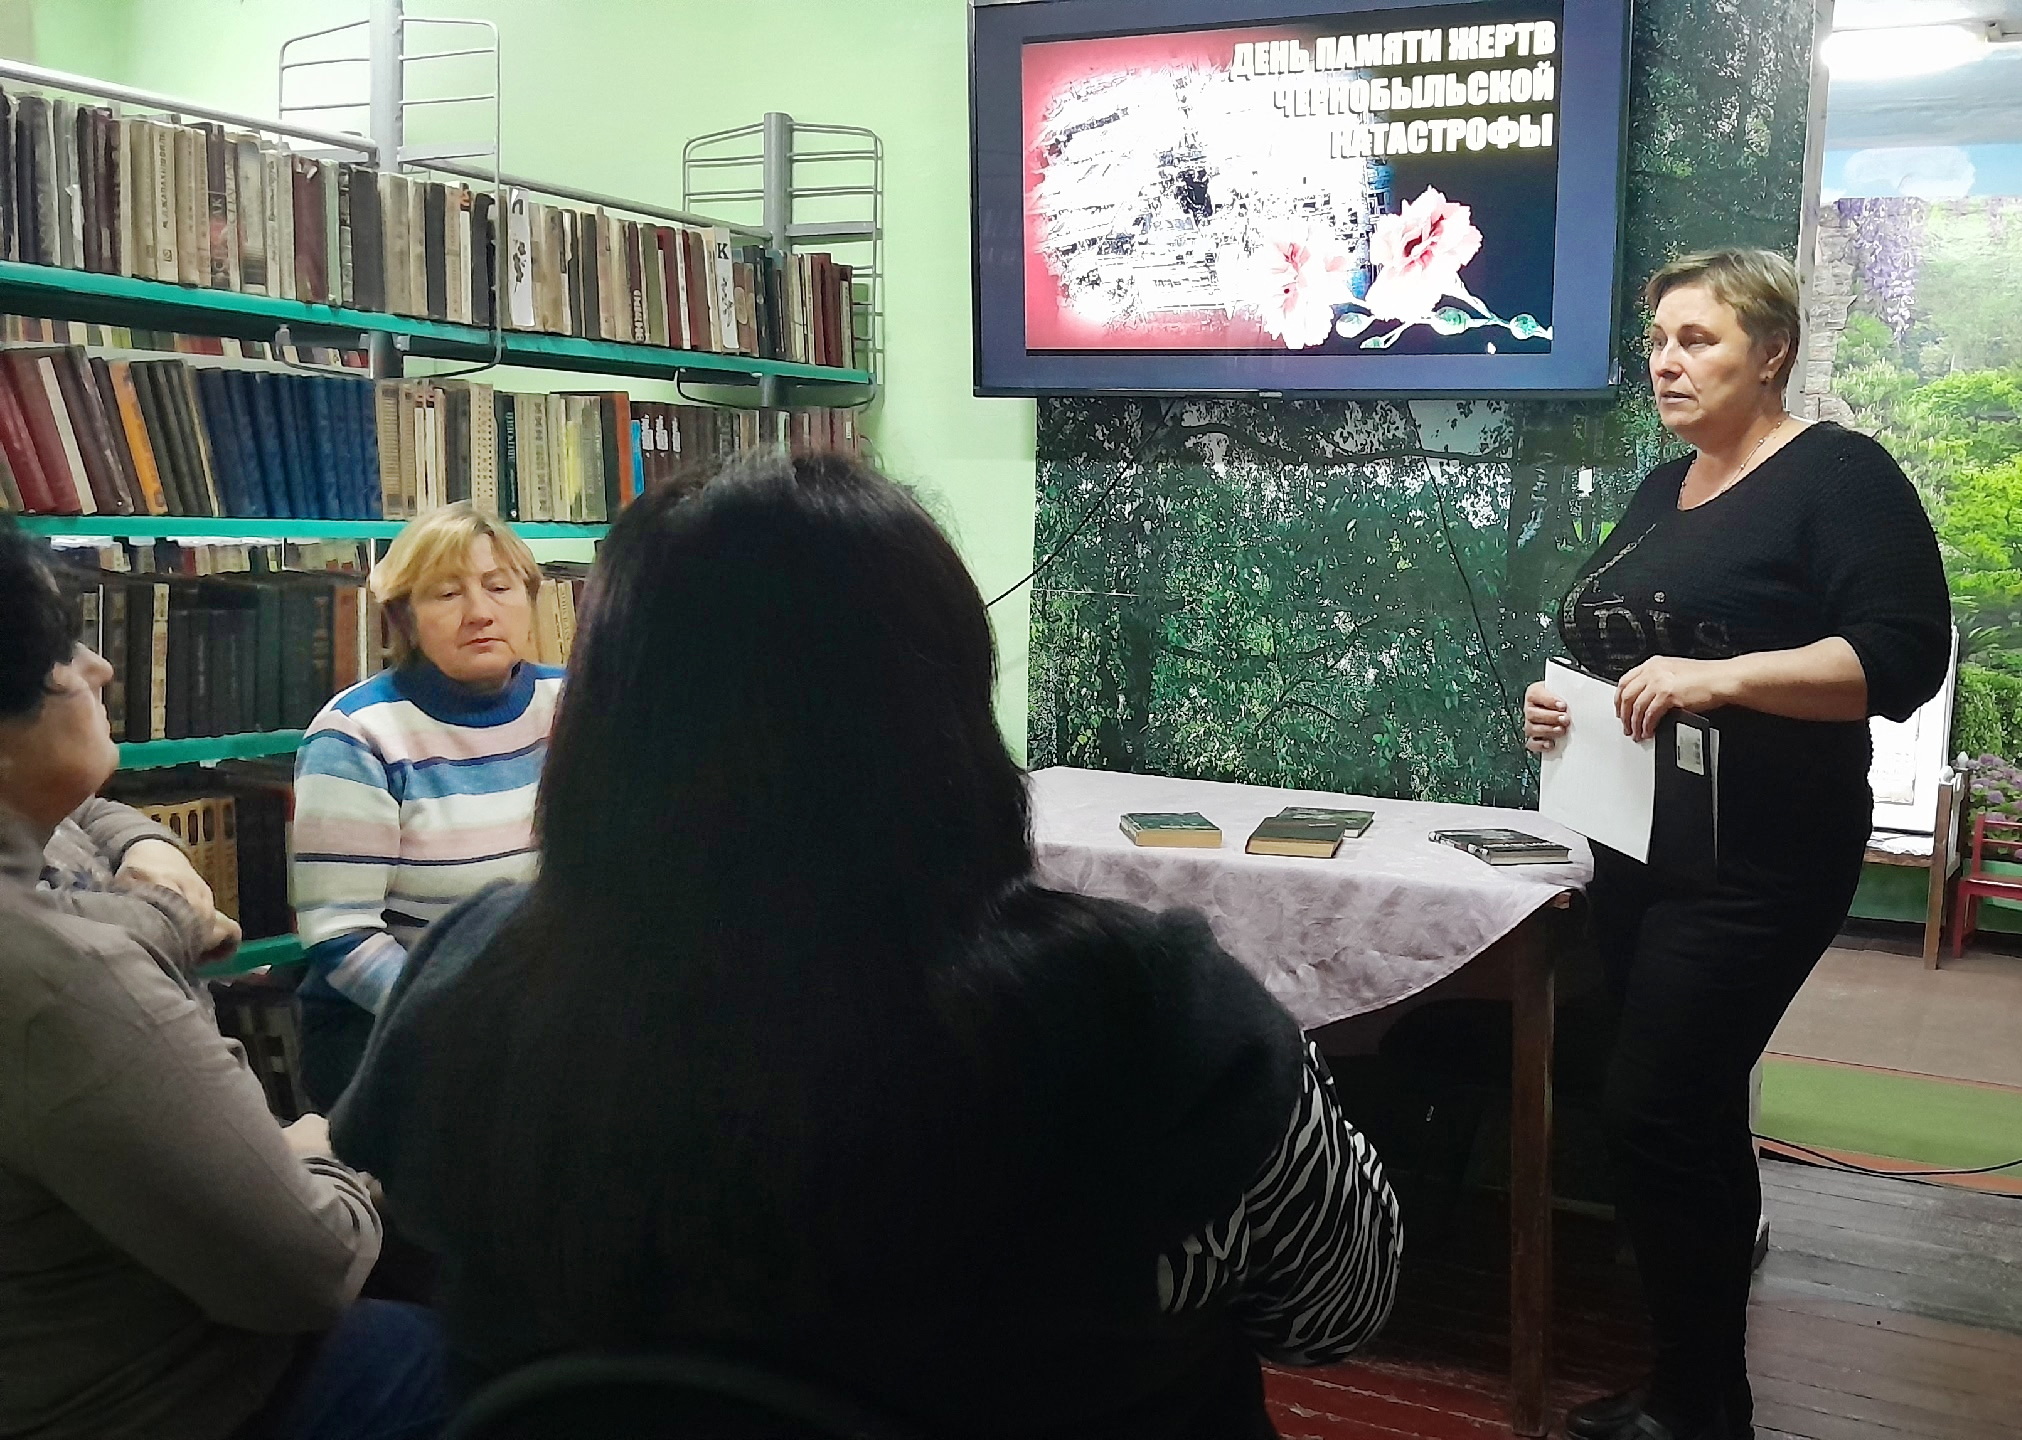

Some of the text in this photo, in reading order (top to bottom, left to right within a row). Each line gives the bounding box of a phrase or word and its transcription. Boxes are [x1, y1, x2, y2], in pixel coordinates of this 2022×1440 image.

[1228, 20, 1556, 82] ДЕНЬ ПАМЯТИ ЖЕРТВ
[1274, 60, 1555, 118] ЧЕРНОБЫЛЬСКОЙ
[1330, 113, 1554, 159] КАТАСТРОФЫ
